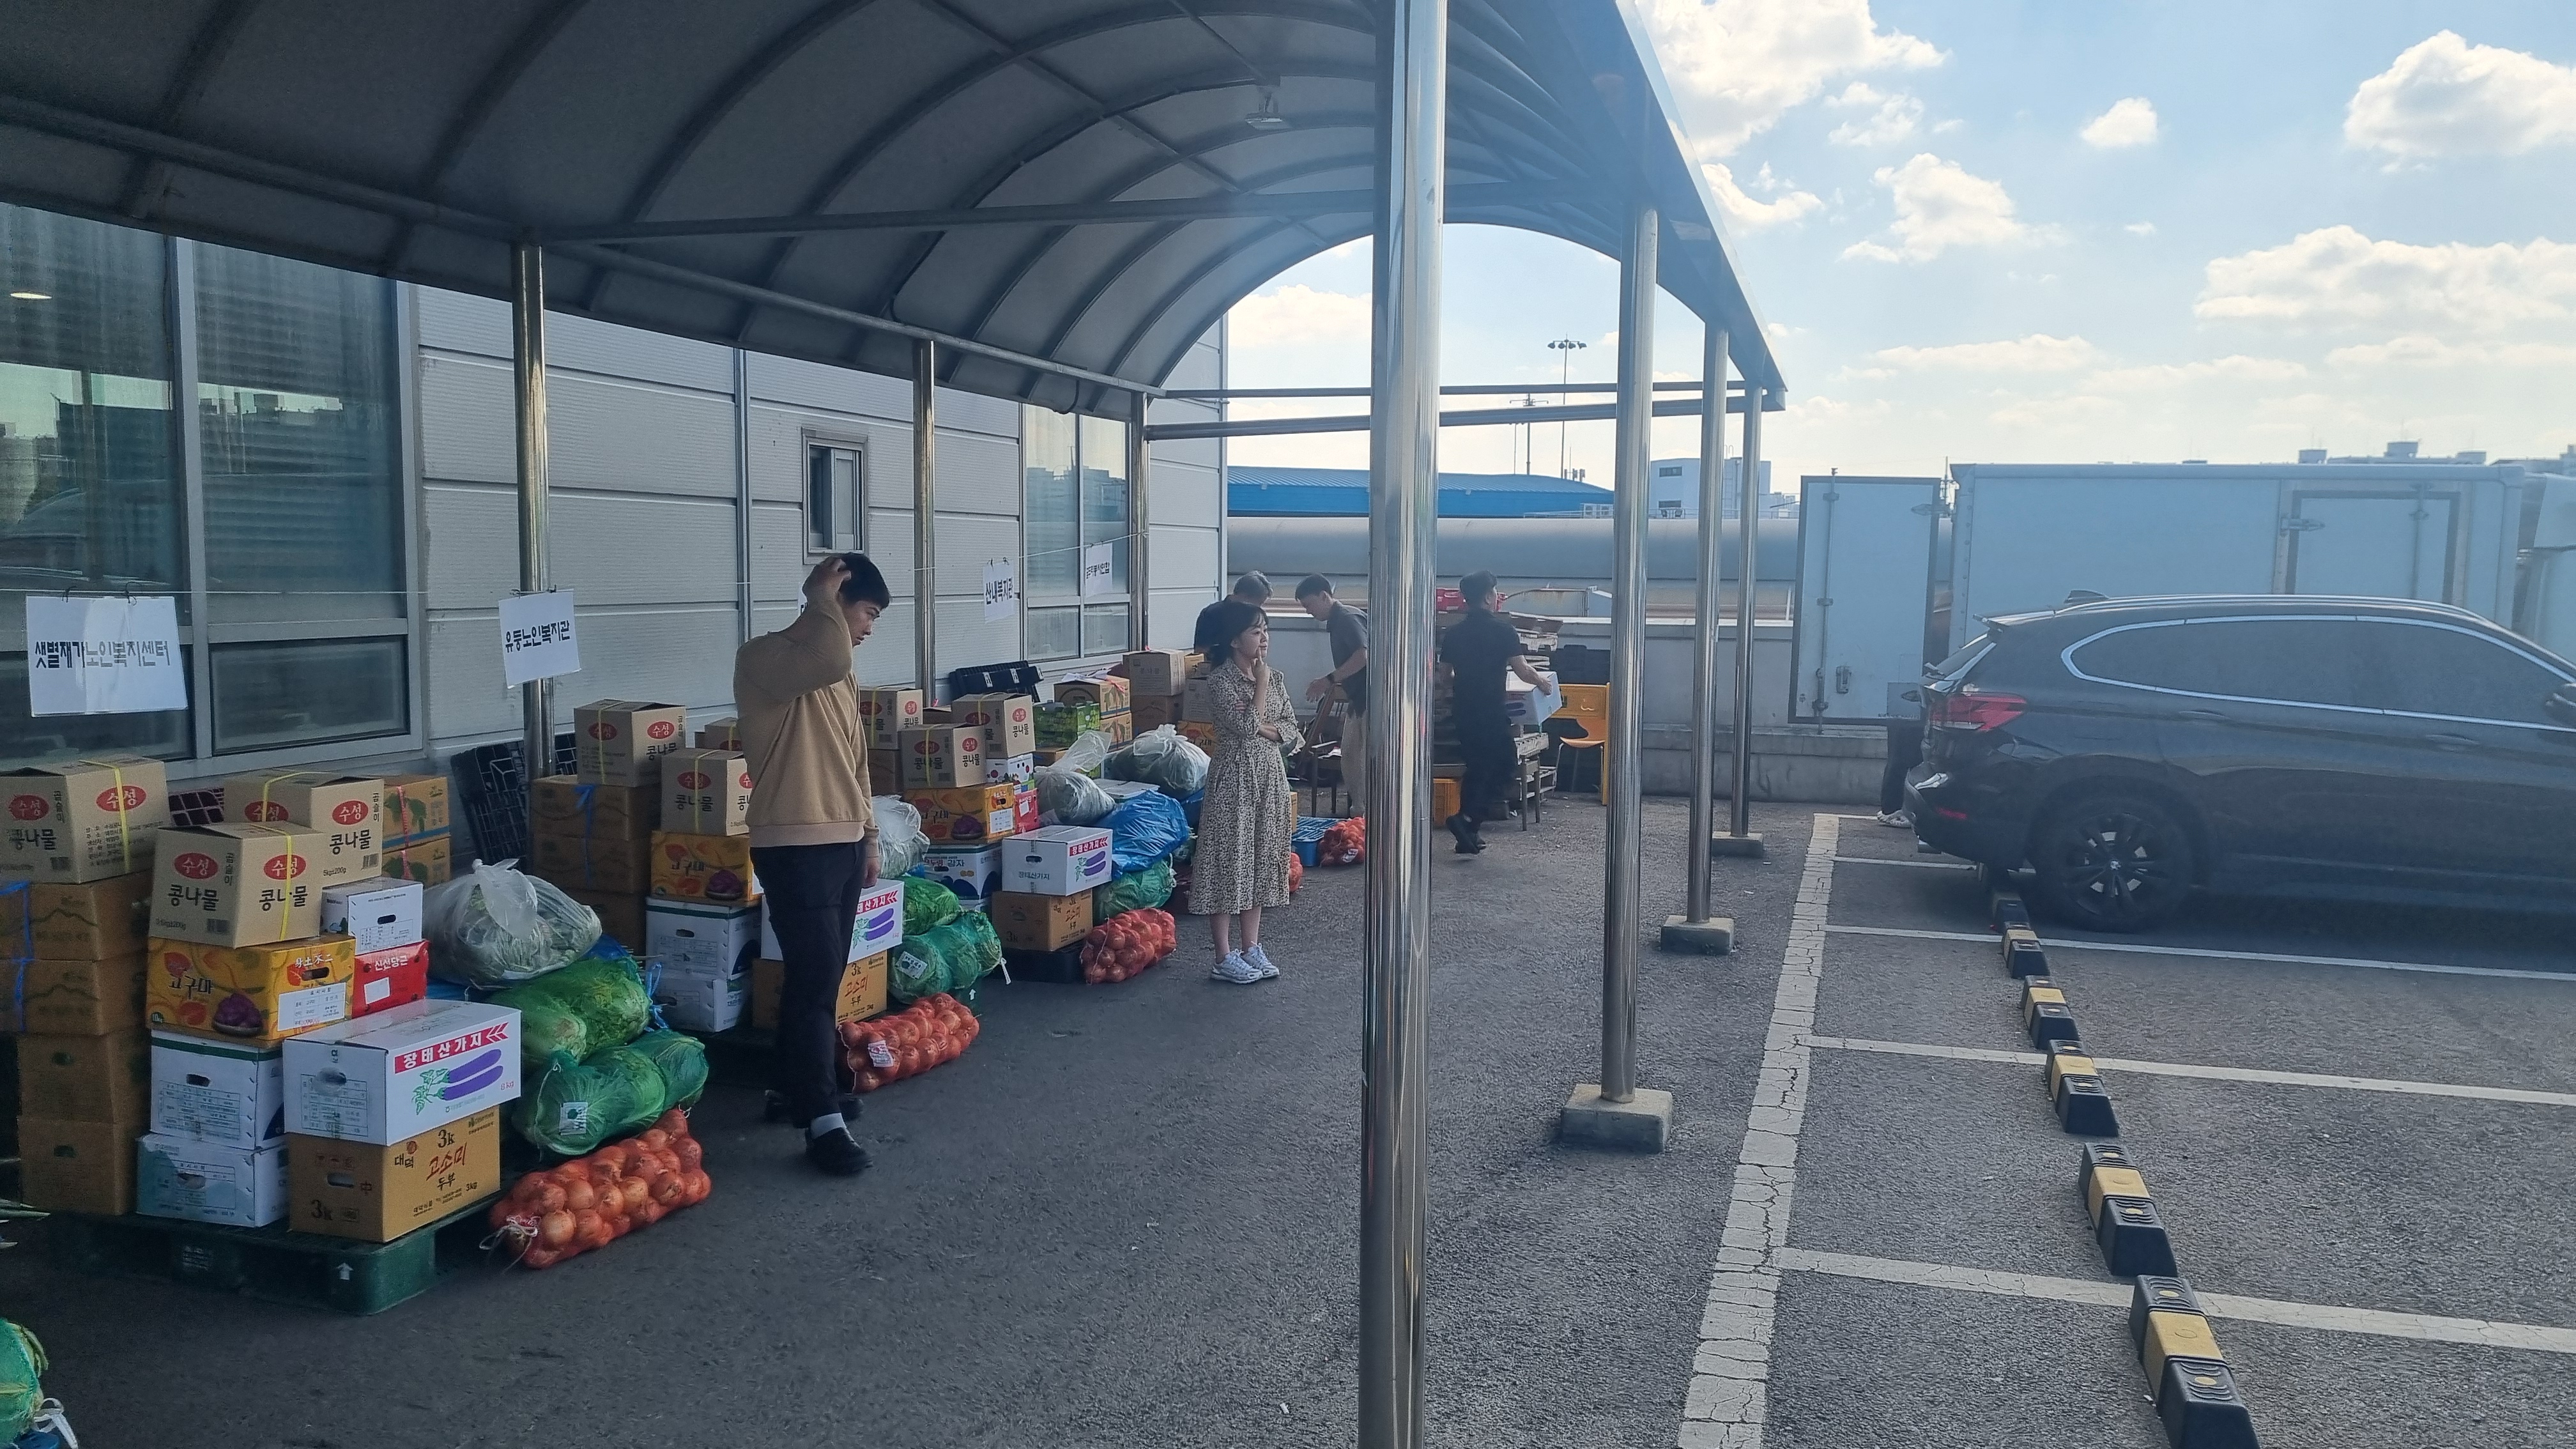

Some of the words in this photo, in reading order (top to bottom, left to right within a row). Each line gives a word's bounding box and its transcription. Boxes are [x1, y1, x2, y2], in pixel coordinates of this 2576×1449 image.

[985, 576, 1013, 604] 산내복지관
[505, 620, 571, 653] 유등노인복지관
[35, 641, 170, 668] 샛별재가노인복지센터
[652, 723, 670, 737] 수성
[1012, 724, 1029, 738] 콩나물
[962, 754, 980, 767] 콩나물
[107, 788, 137, 810] 수성
[339, 803, 362, 822] 수성
[8, 829, 56, 850] 콩나물
[330, 829, 371, 855] 콩나물
[182, 857, 209, 876] 수성
[272, 857, 298, 876] 수성
[168, 884, 219, 912] 콩나물
[259, 885, 308, 912] 콩나물
[374, 955, 408, 971] 신선당근
[169, 967, 214, 1000] 고구마
[403, 1032, 482, 1069] 장태산가지
[438, 1129, 455, 1148] 3k
[394, 1153, 414, 1169] 대덕
[426, 1141, 467, 1181] 고소미
[437, 1172, 456, 1191] 두부
